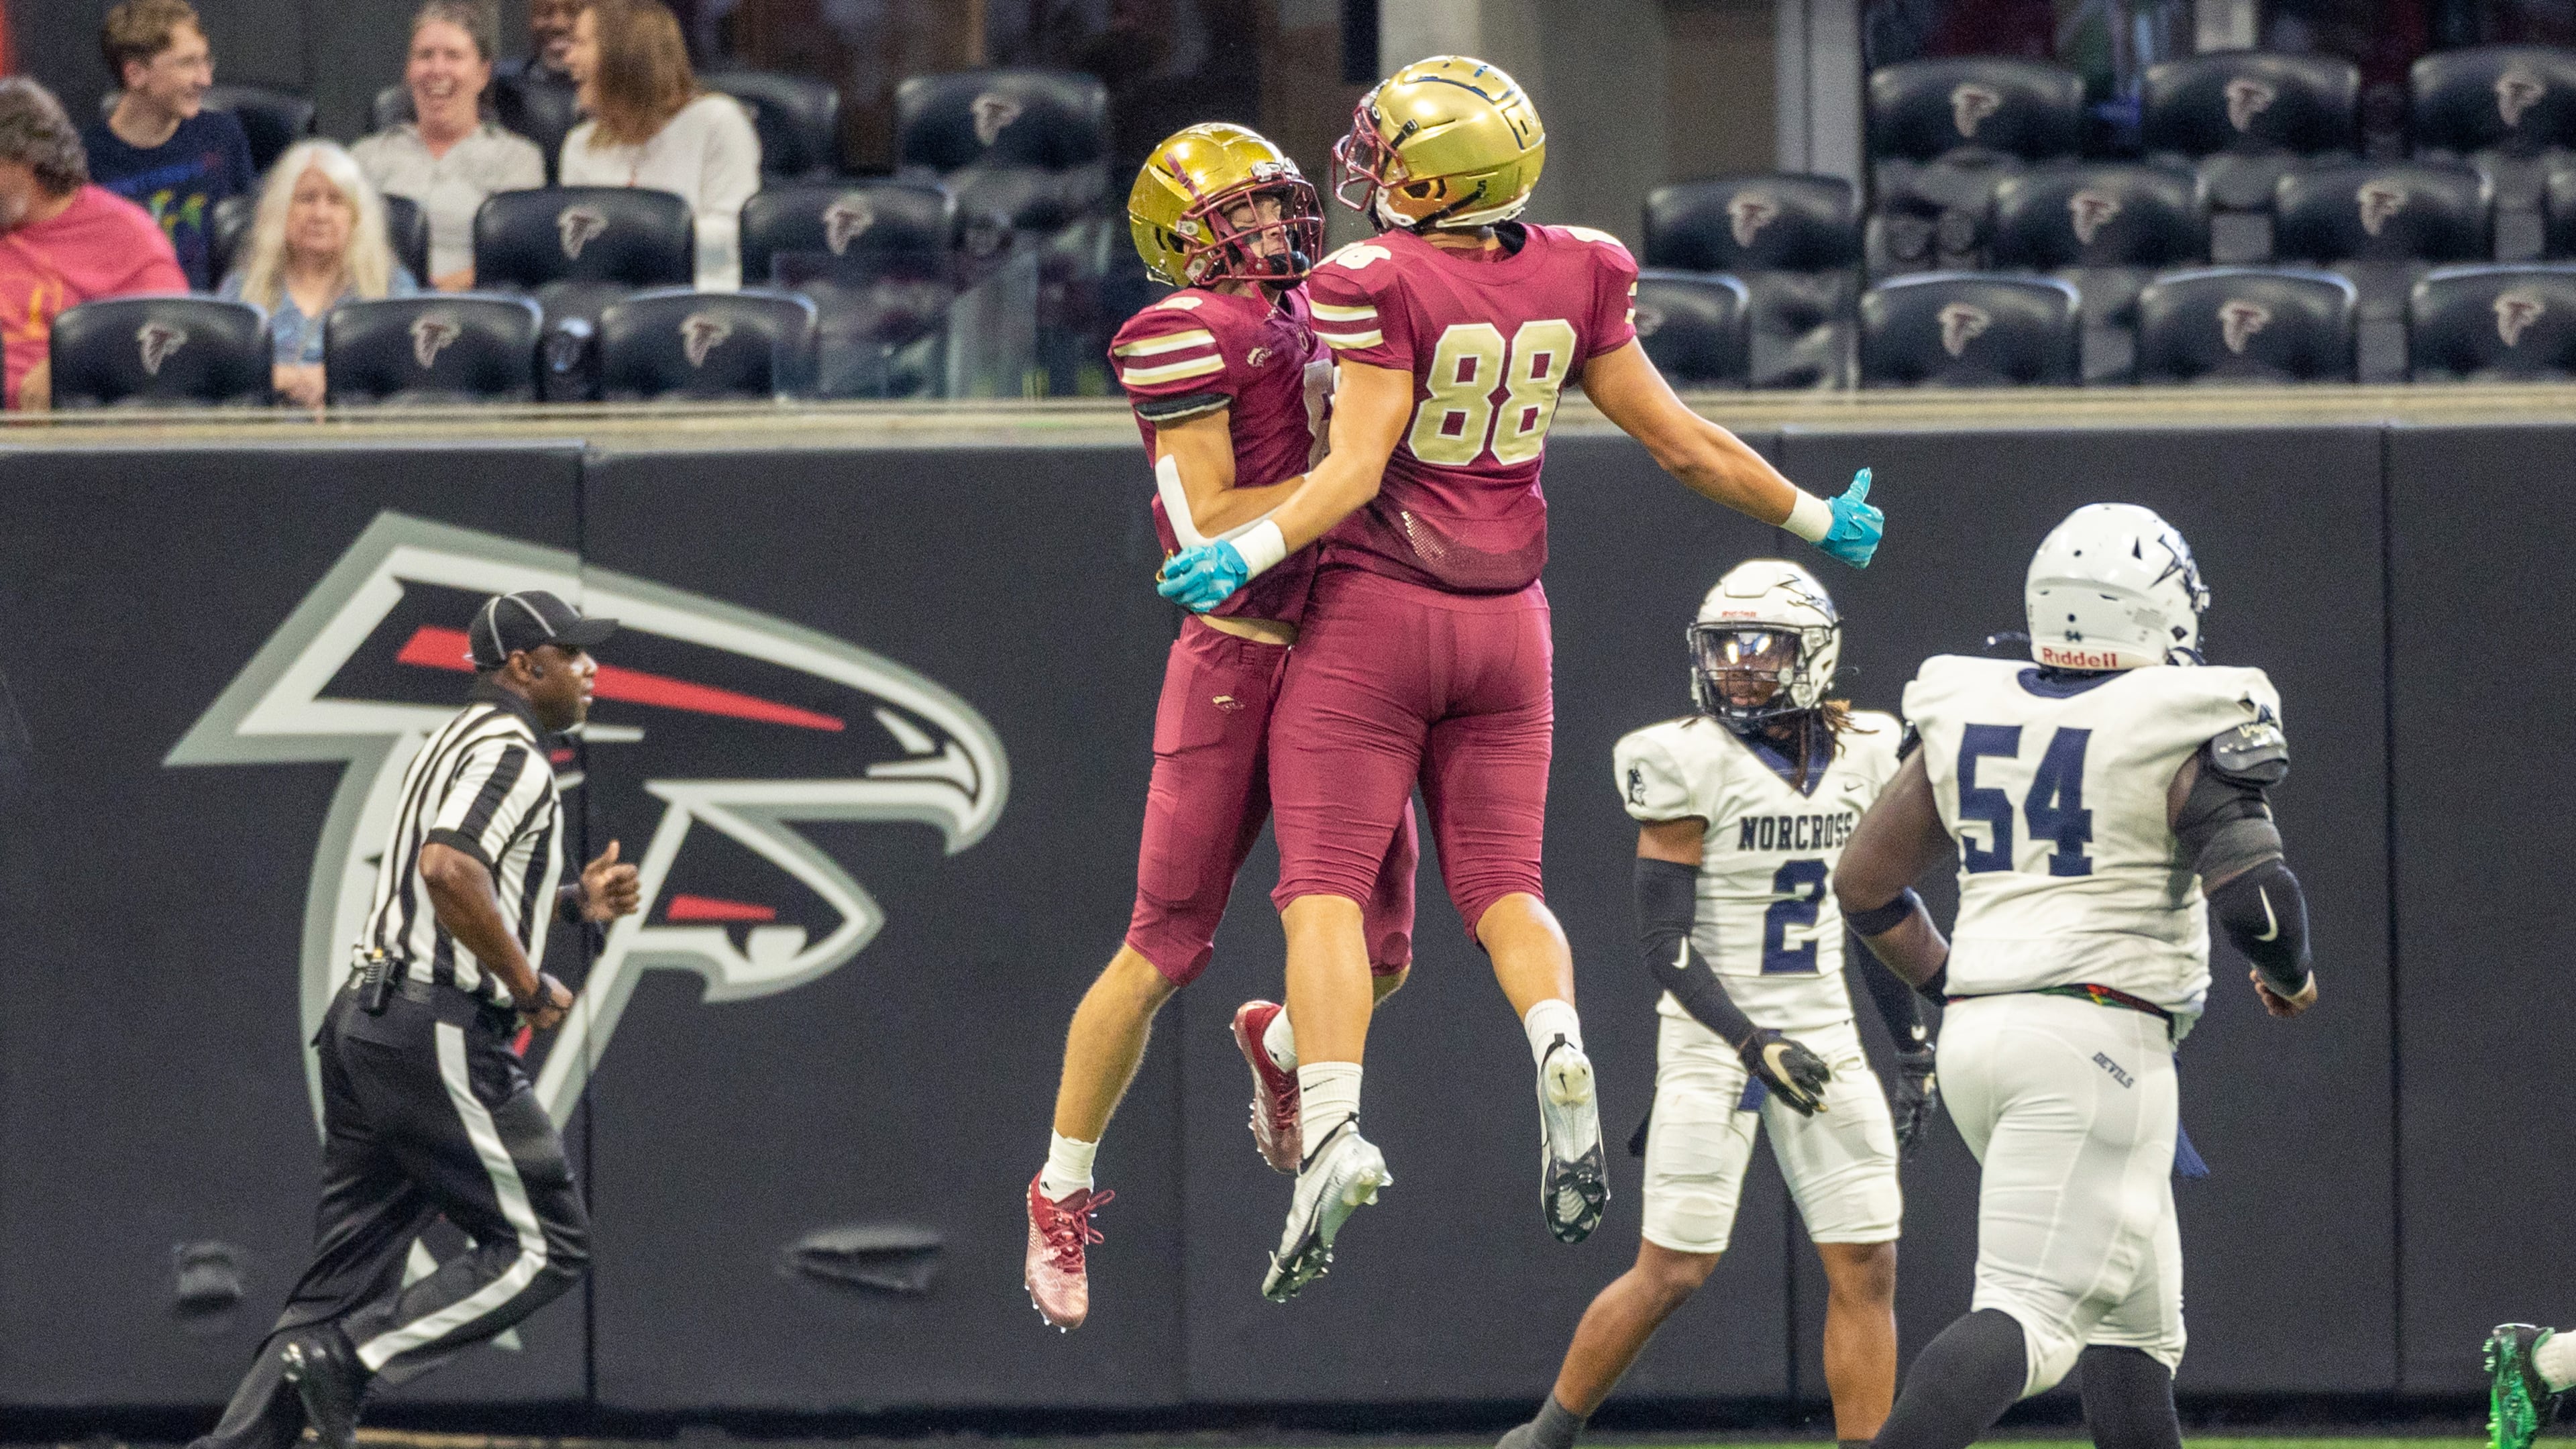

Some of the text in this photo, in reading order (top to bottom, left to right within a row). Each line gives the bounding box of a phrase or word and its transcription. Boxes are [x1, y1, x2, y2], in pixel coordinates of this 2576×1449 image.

[1408, 319, 1576, 466] 88
[2041, 647, 2118, 668] Riddell
[1737, 812, 1853, 851] NORCROSS
[1956, 722, 2093, 876] 54
[1760, 858, 1829, 975] 2
[2092, 1052, 2134, 1088] DEVILS
